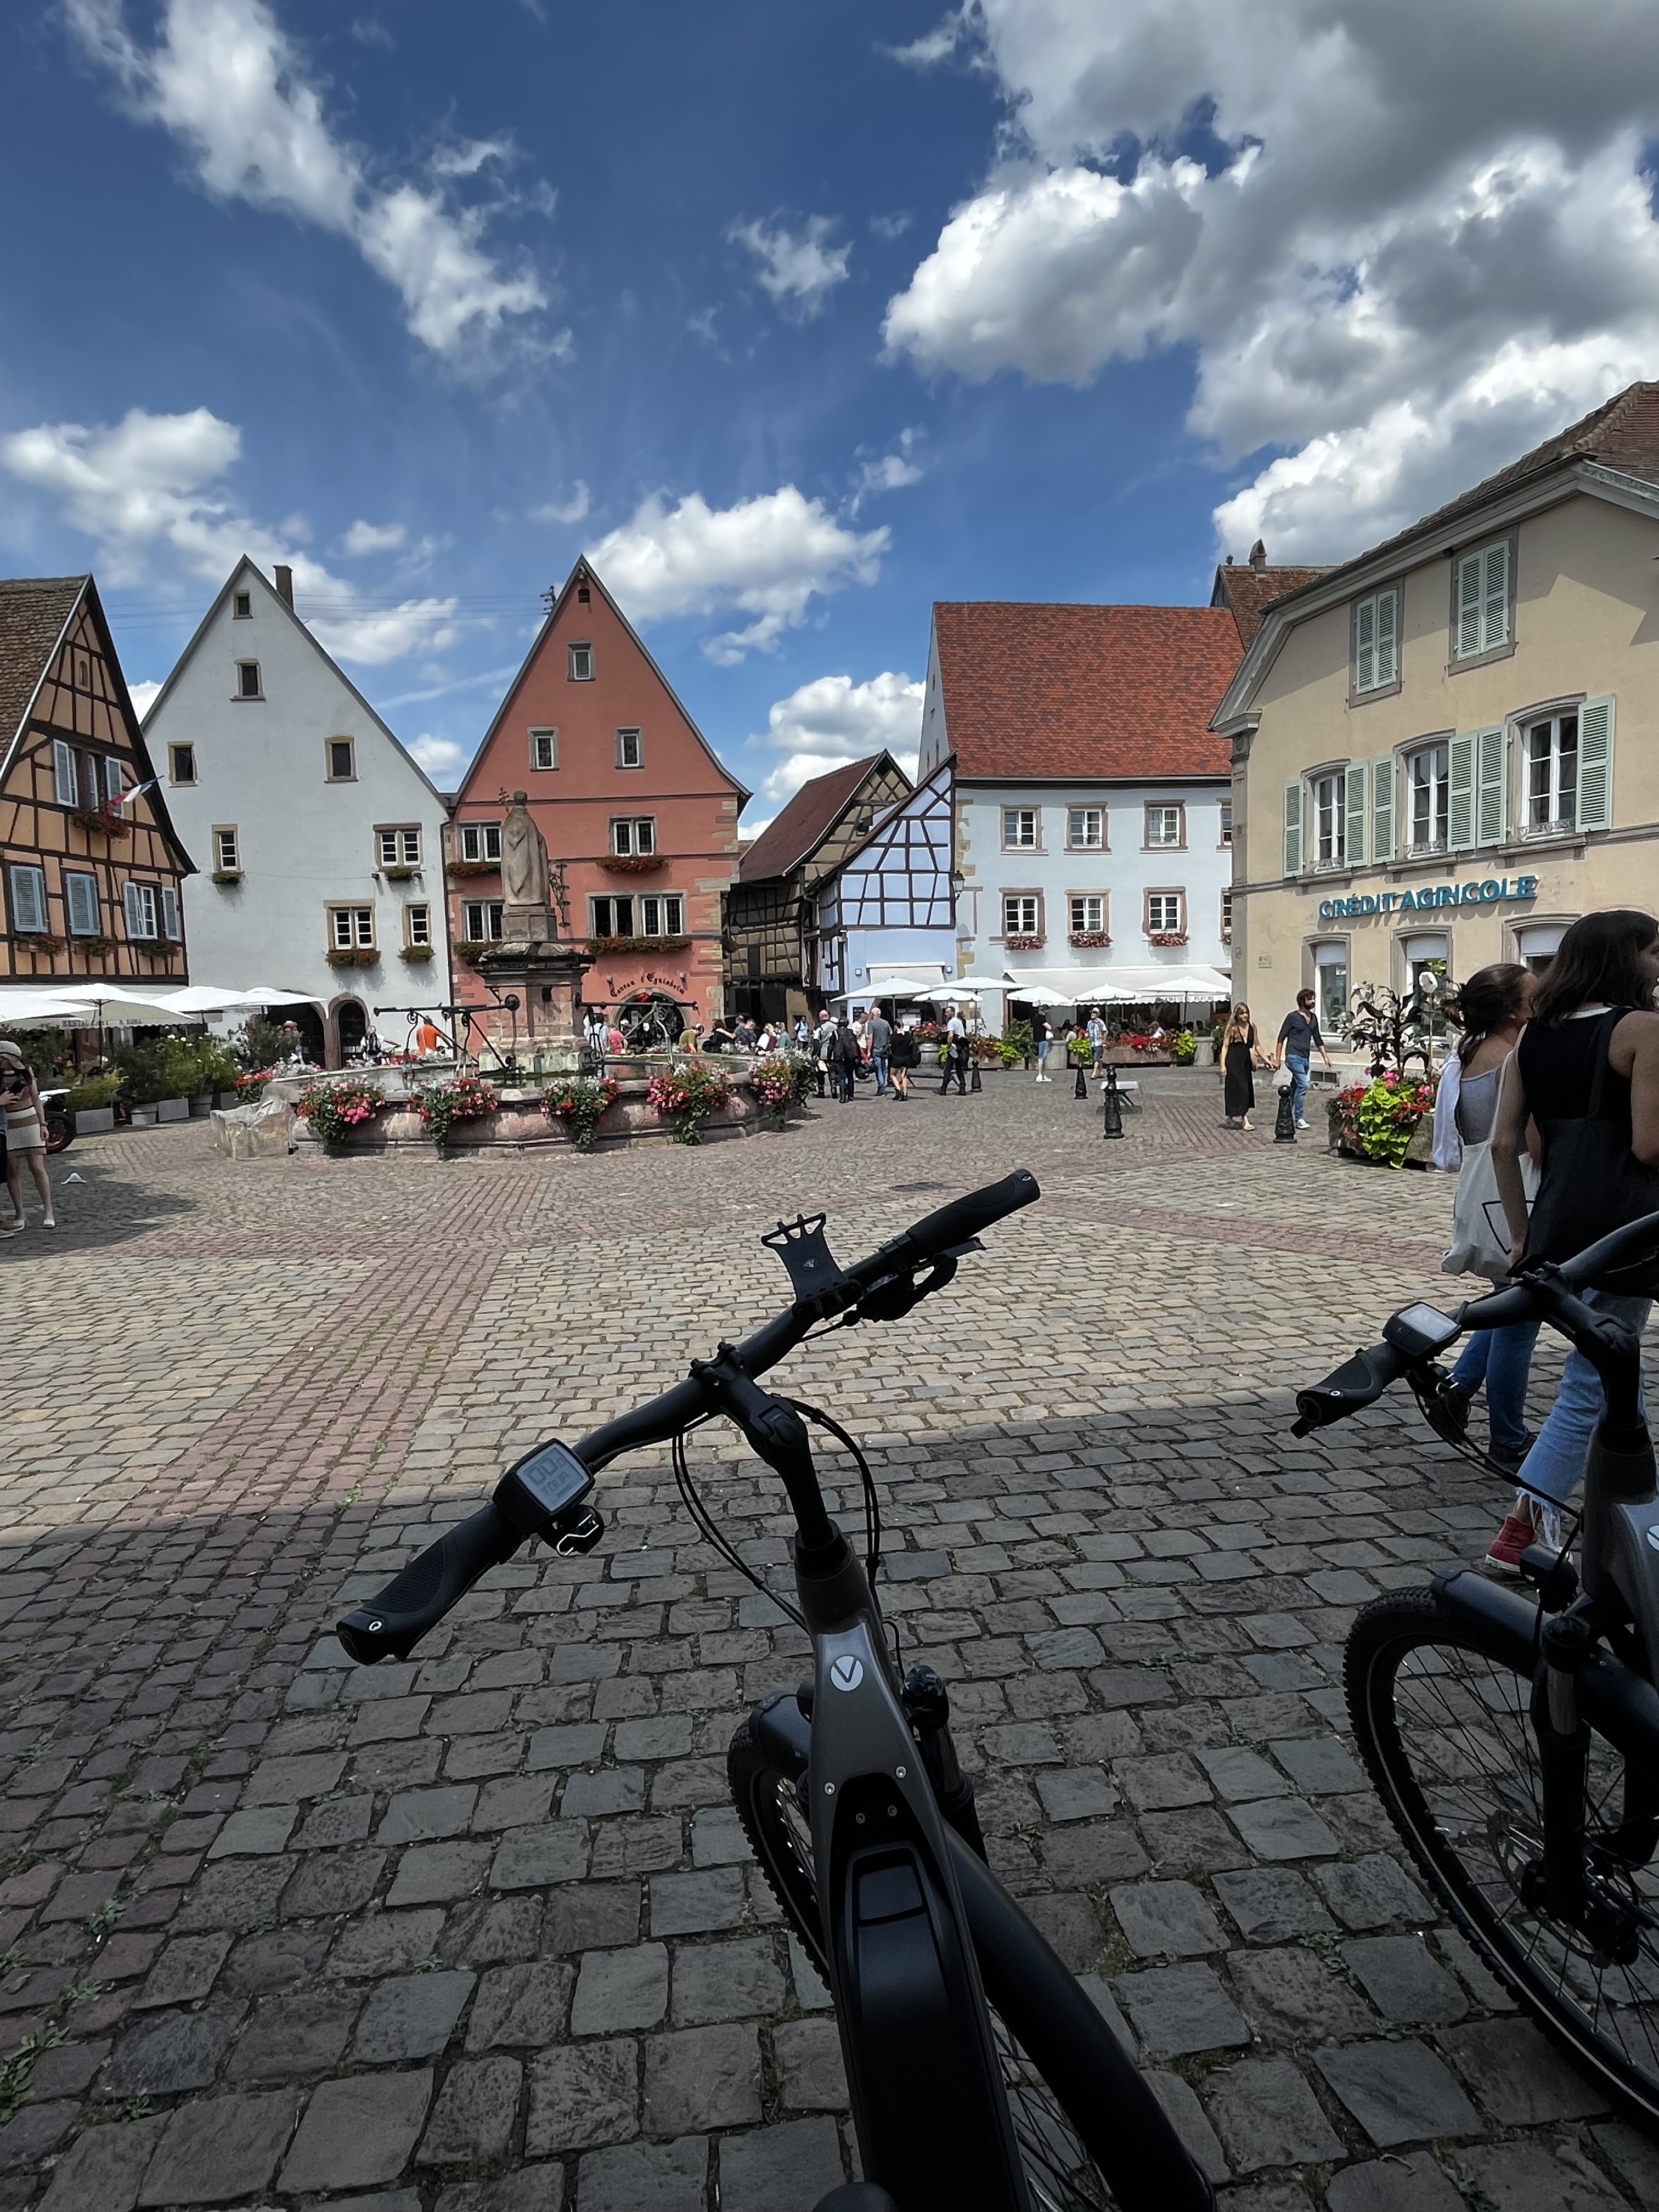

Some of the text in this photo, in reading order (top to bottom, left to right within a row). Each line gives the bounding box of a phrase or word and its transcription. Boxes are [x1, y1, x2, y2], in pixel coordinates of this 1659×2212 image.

[1319, 875, 1539, 919] CRÉDIT AGRICOLE
[540, 1471, 571, 1496] TOUR
